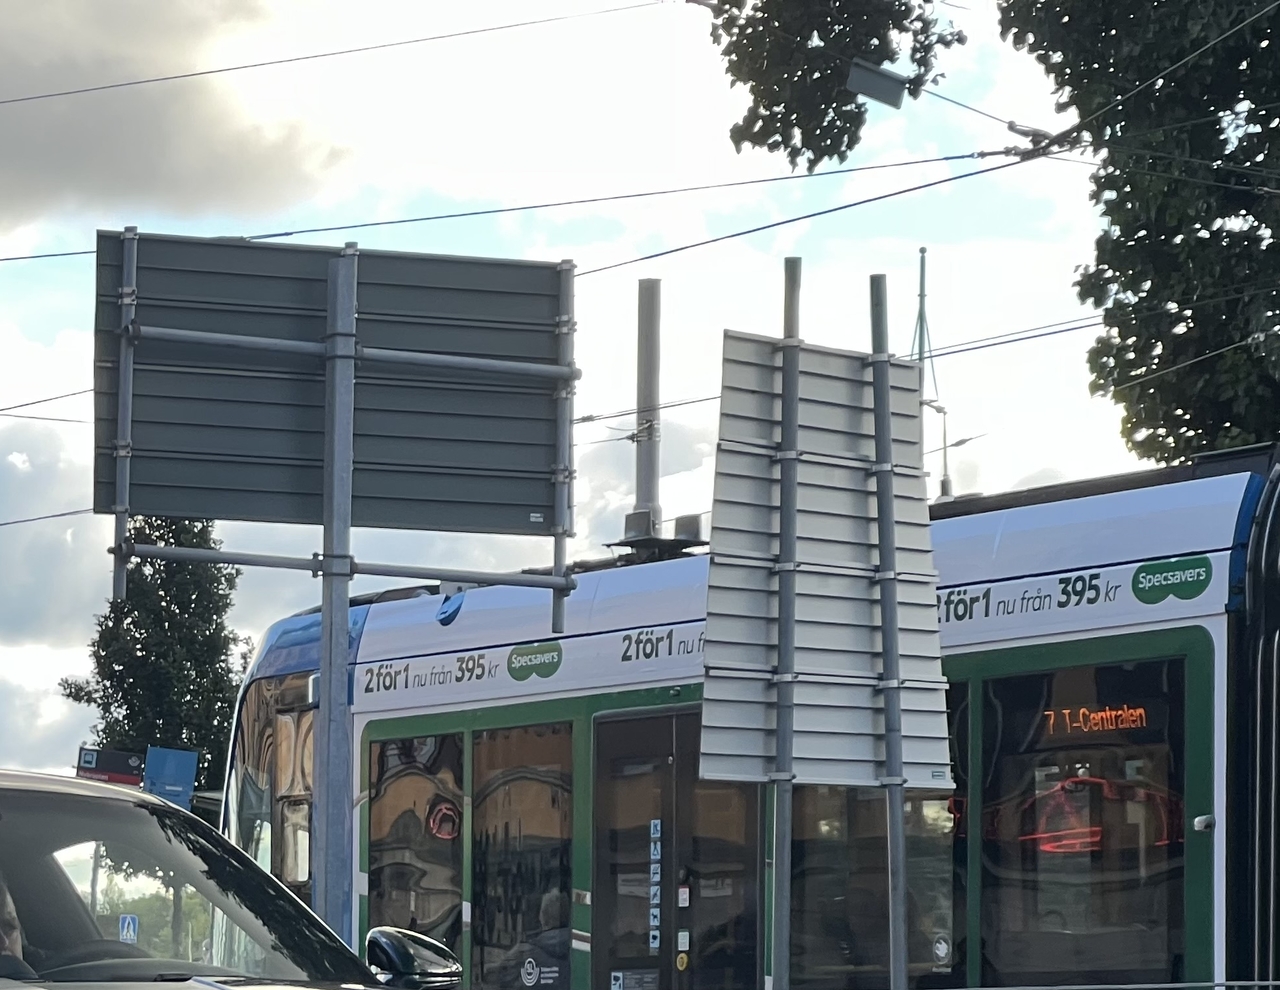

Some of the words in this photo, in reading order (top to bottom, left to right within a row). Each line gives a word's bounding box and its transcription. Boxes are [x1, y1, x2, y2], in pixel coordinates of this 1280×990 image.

[1138, 566, 1206, 589] Specsavers
[938, 587, 992, 623] för1
[996, 598, 1017, 616] nu
[1020, 589, 1052, 613] från
[1057, 573, 1101, 609] 395
[1104, 581, 1122, 602] kr
[511, 650, 559, 669] Specsavers
[677, 639, 695, 655] nu
[412, 674, 428, 689] nu
[429, 664, 452, 686] från
[455, 654, 486, 683] 395
[487, 661, 500, 679] kr
[1044, 711, 1055, 735] 7
[1061, 704, 1147, 733] T-Centralen
